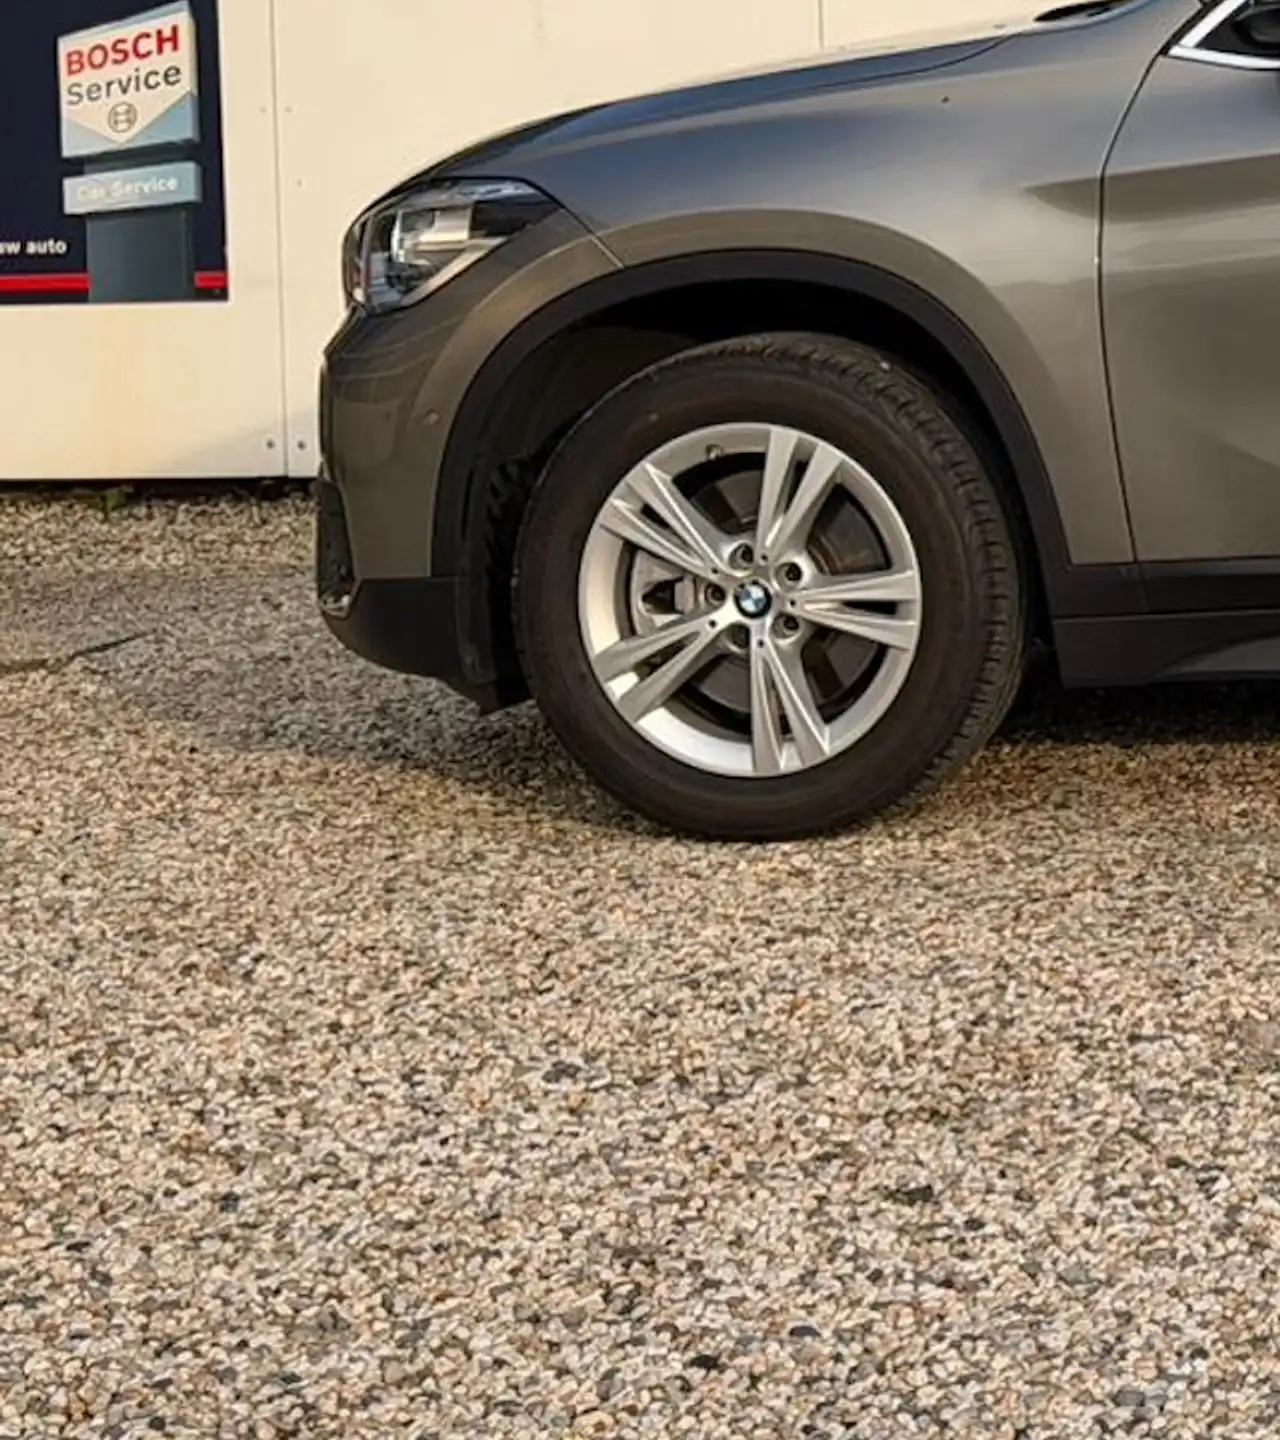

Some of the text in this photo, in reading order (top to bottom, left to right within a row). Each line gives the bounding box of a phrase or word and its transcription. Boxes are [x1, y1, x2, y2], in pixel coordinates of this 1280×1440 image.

[65, 24, 181, 77] BOSCH
[66, 63, 182, 106] Service
[111, 175, 179, 196] Service
[26, 237, 68, 255] auto
